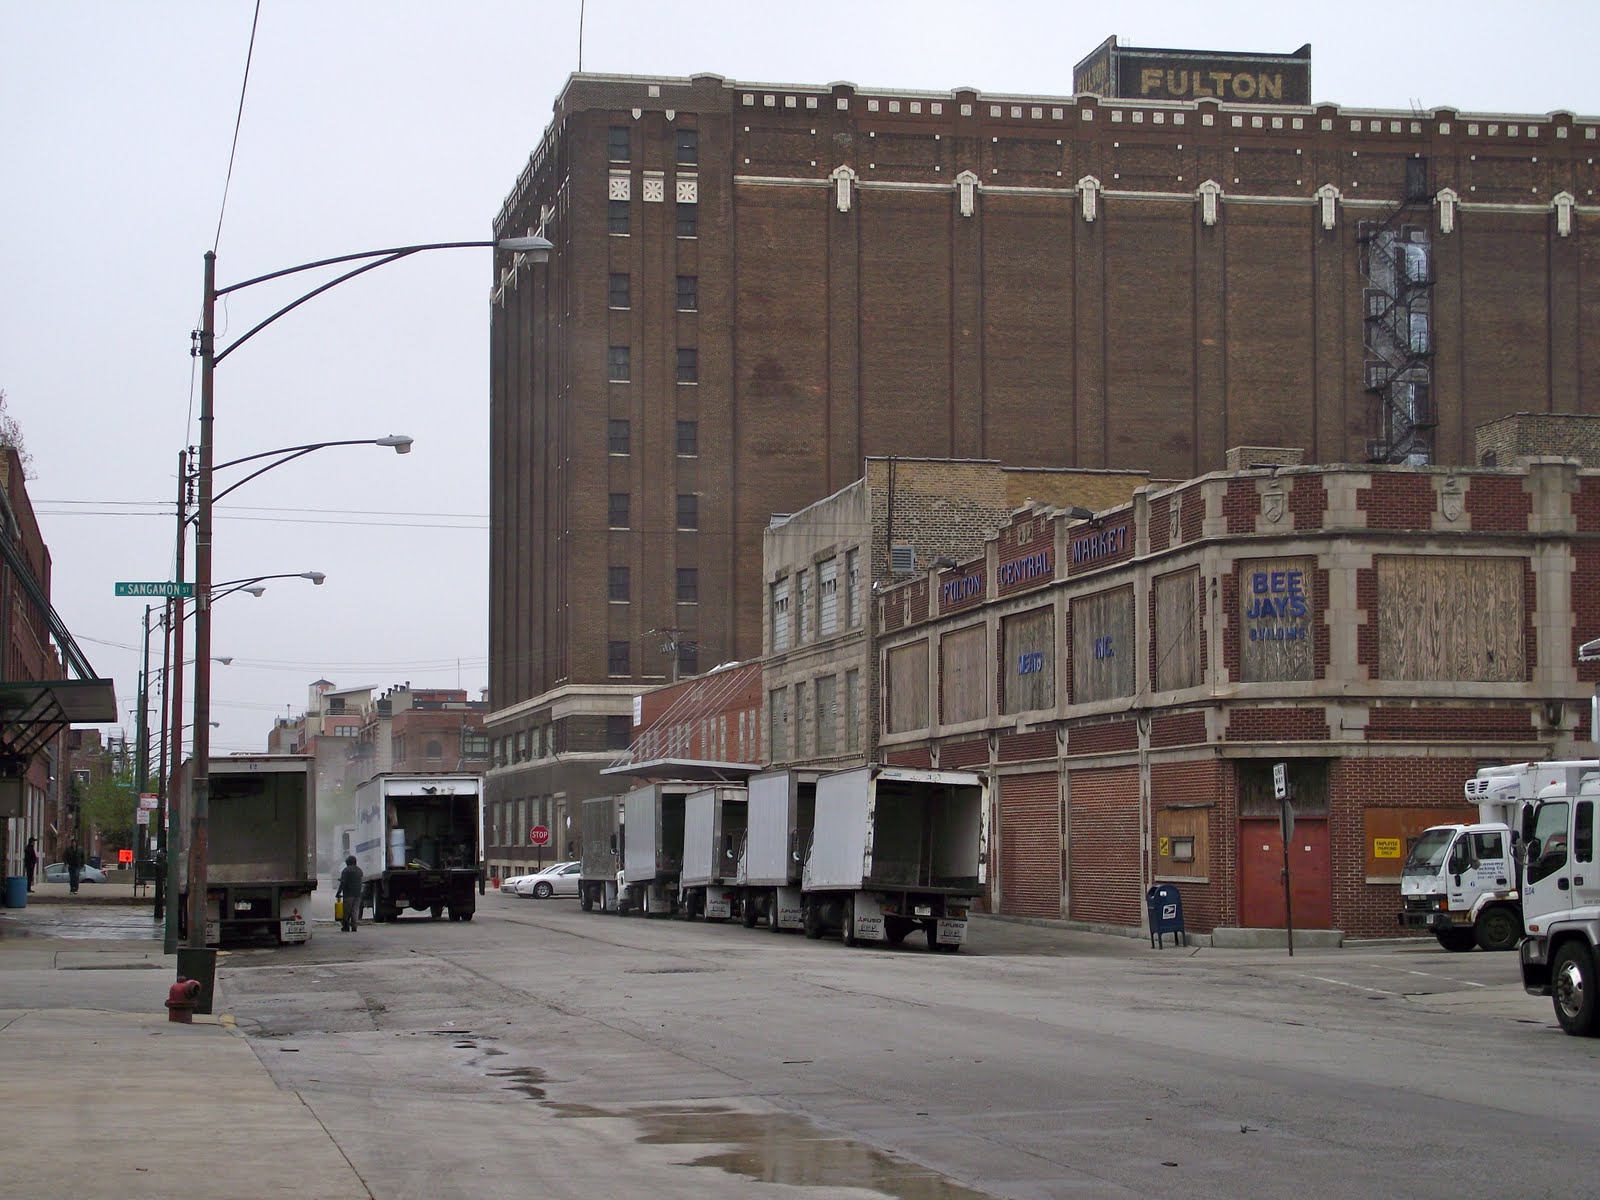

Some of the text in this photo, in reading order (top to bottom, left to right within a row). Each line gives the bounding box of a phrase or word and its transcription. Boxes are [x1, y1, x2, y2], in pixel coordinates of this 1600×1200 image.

[1140, 69, 1283, 99] FULTON
[943, 526, 1126, 606] FULTON CENTRAL MARKET
[1253, 571, 1303, 593] BEE
[127, 583, 180, 595] SANGAMON
[1250, 627, 1305, 641] BUILDING
[1274, 766, 1283, 777] ONE
[1275, 777, 1283, 785] WAY
[531, 830, 548, 839] STOP
